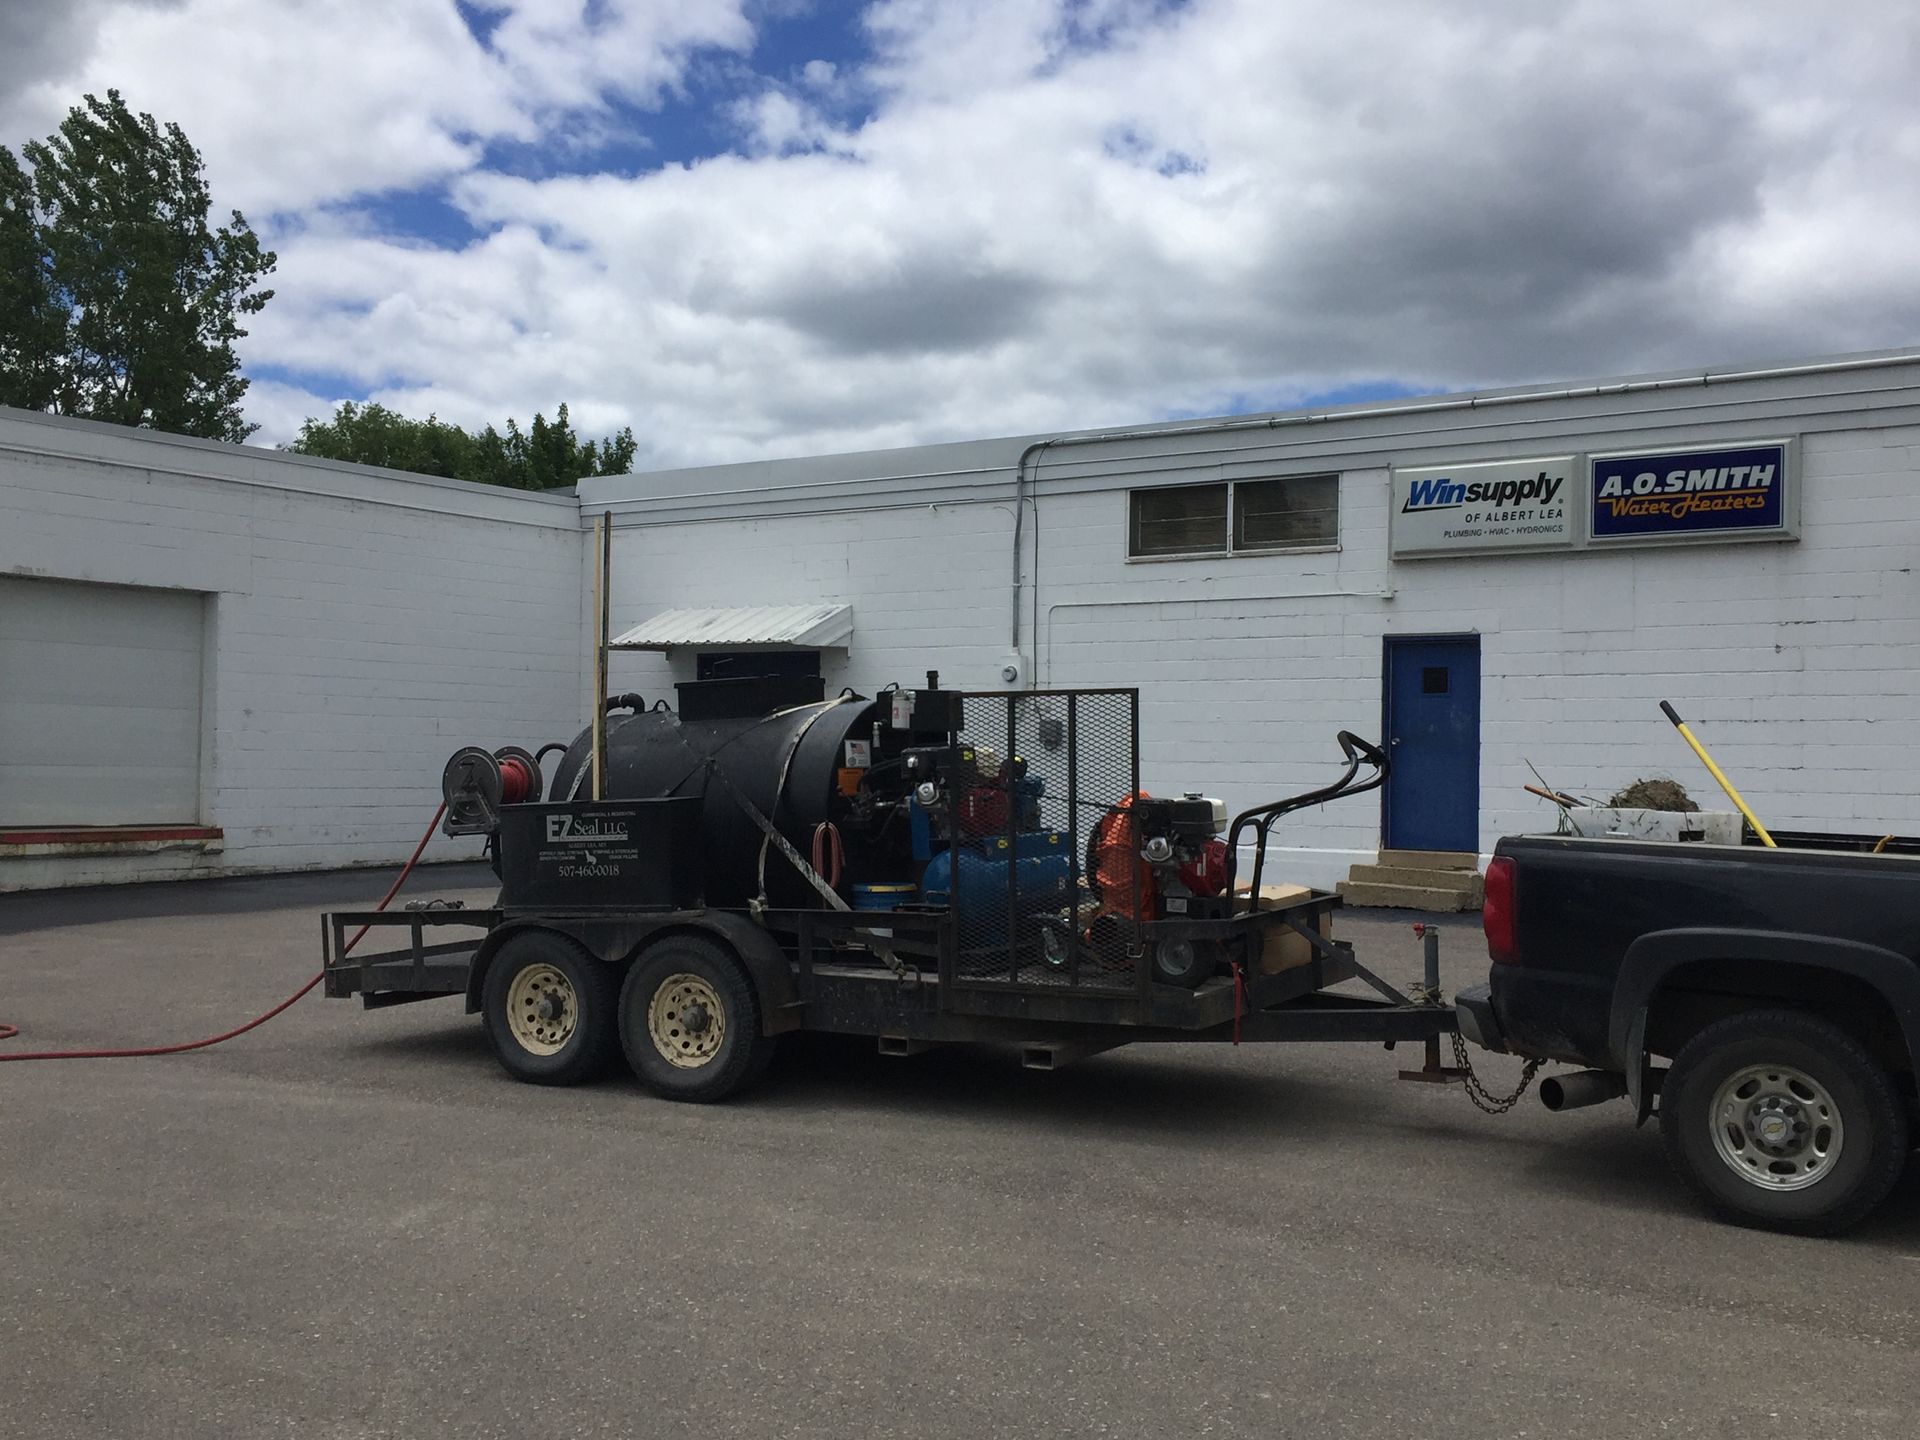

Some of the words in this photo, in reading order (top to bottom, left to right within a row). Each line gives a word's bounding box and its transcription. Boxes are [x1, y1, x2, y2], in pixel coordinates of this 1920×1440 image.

[1408, 471, 1564, 507] Winsupply
[1465, 513, 1481, 523] OF
[1485, 510, 1535, 522] ALBERT
[1539, 508, 1563, 519] LEA
[1611, 496, 1671, 518] Water
[1671, 492, 1766, 519] Heaters
[1443, 528, 1482, 538] PLUMBING
[1489, 527, 1510, 536] HVAC
[1516, 524, 1564, 534] HYDRONICS
[546, 814, 573, 842] EZ
[574, 818, 599, 835] Seal
[558, 864, 620, 877] 507-460-0018
